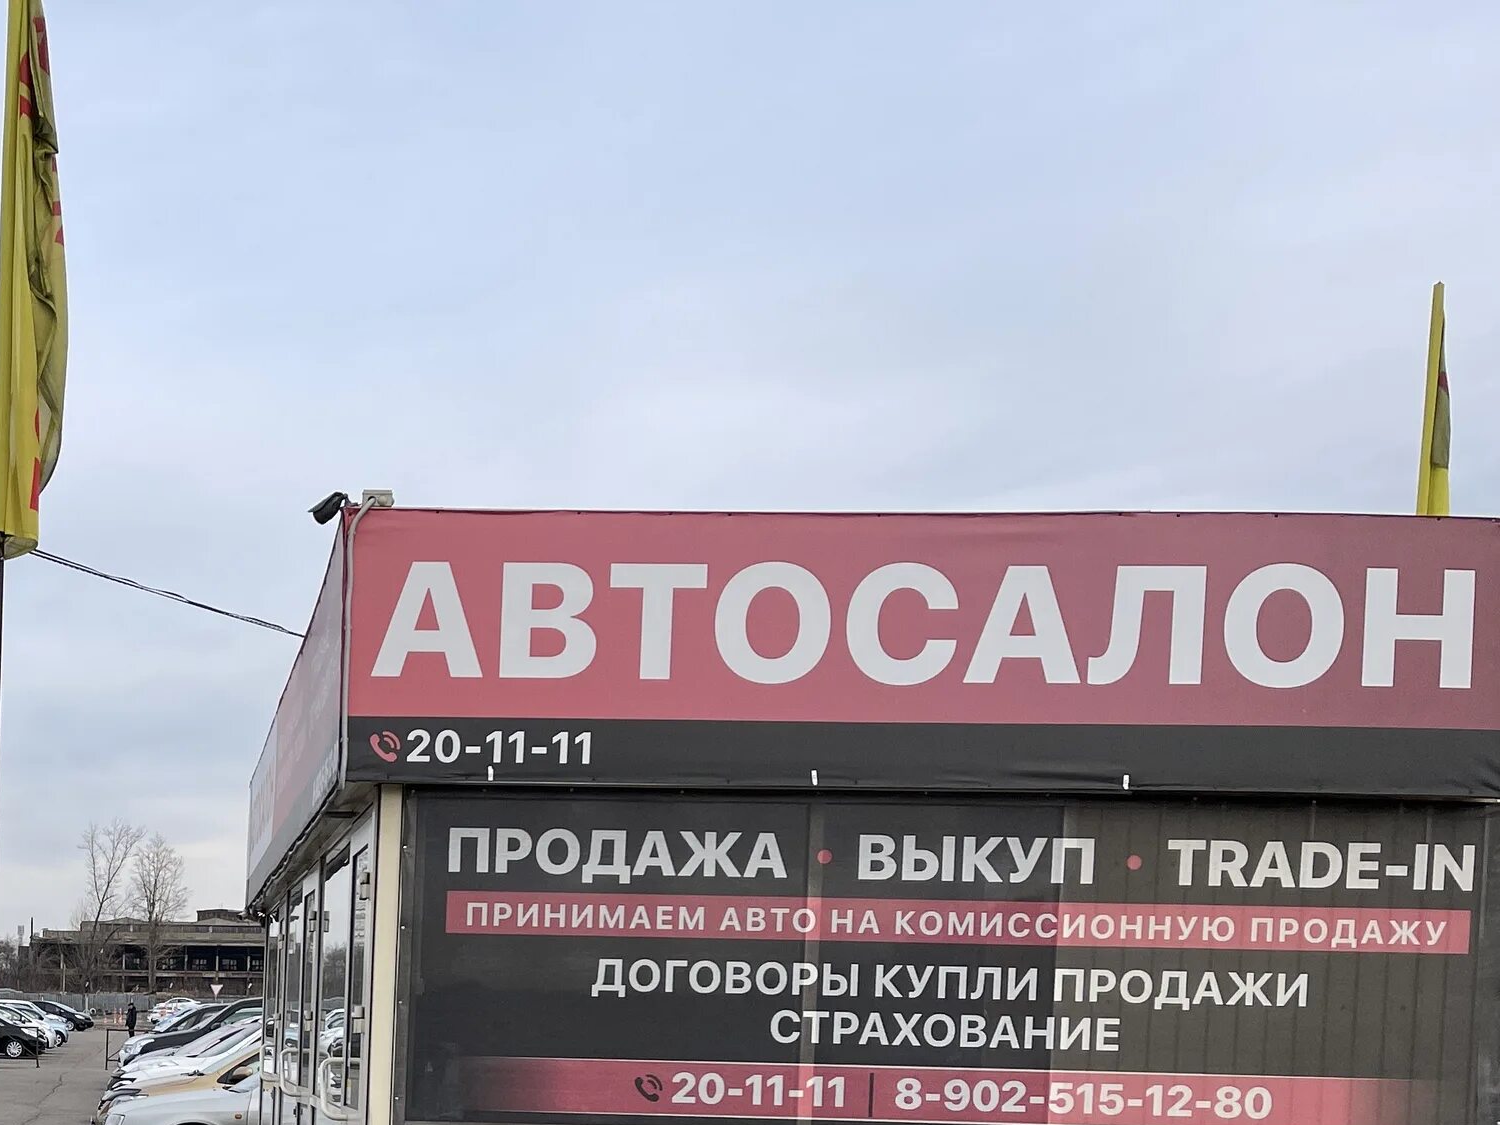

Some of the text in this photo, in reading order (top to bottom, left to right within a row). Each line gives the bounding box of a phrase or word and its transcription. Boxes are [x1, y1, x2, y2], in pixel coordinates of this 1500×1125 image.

[370, 560, 1476, 689] АВТОСАЛОН
[406, 728, 593, 765] 20-11-11
[447, 827, 1476, 892] ПРОДАЖА ВЫКУП TRADE-IN
[465, 901, 1448, 949] ПРИНИМАЕМ АВТО НА КОМИССИОННУЮ ПРОДАЖУ
[590, 957, 1310, 1011] ДОГОВОРЫ КУПЛИ ПРОДАЖИ
[769, 1008, 1121, 1052] СТРАХОВАНИЕ
[670, 1071, 1274, 1120] 20-11-11 8-902-515-12-80
